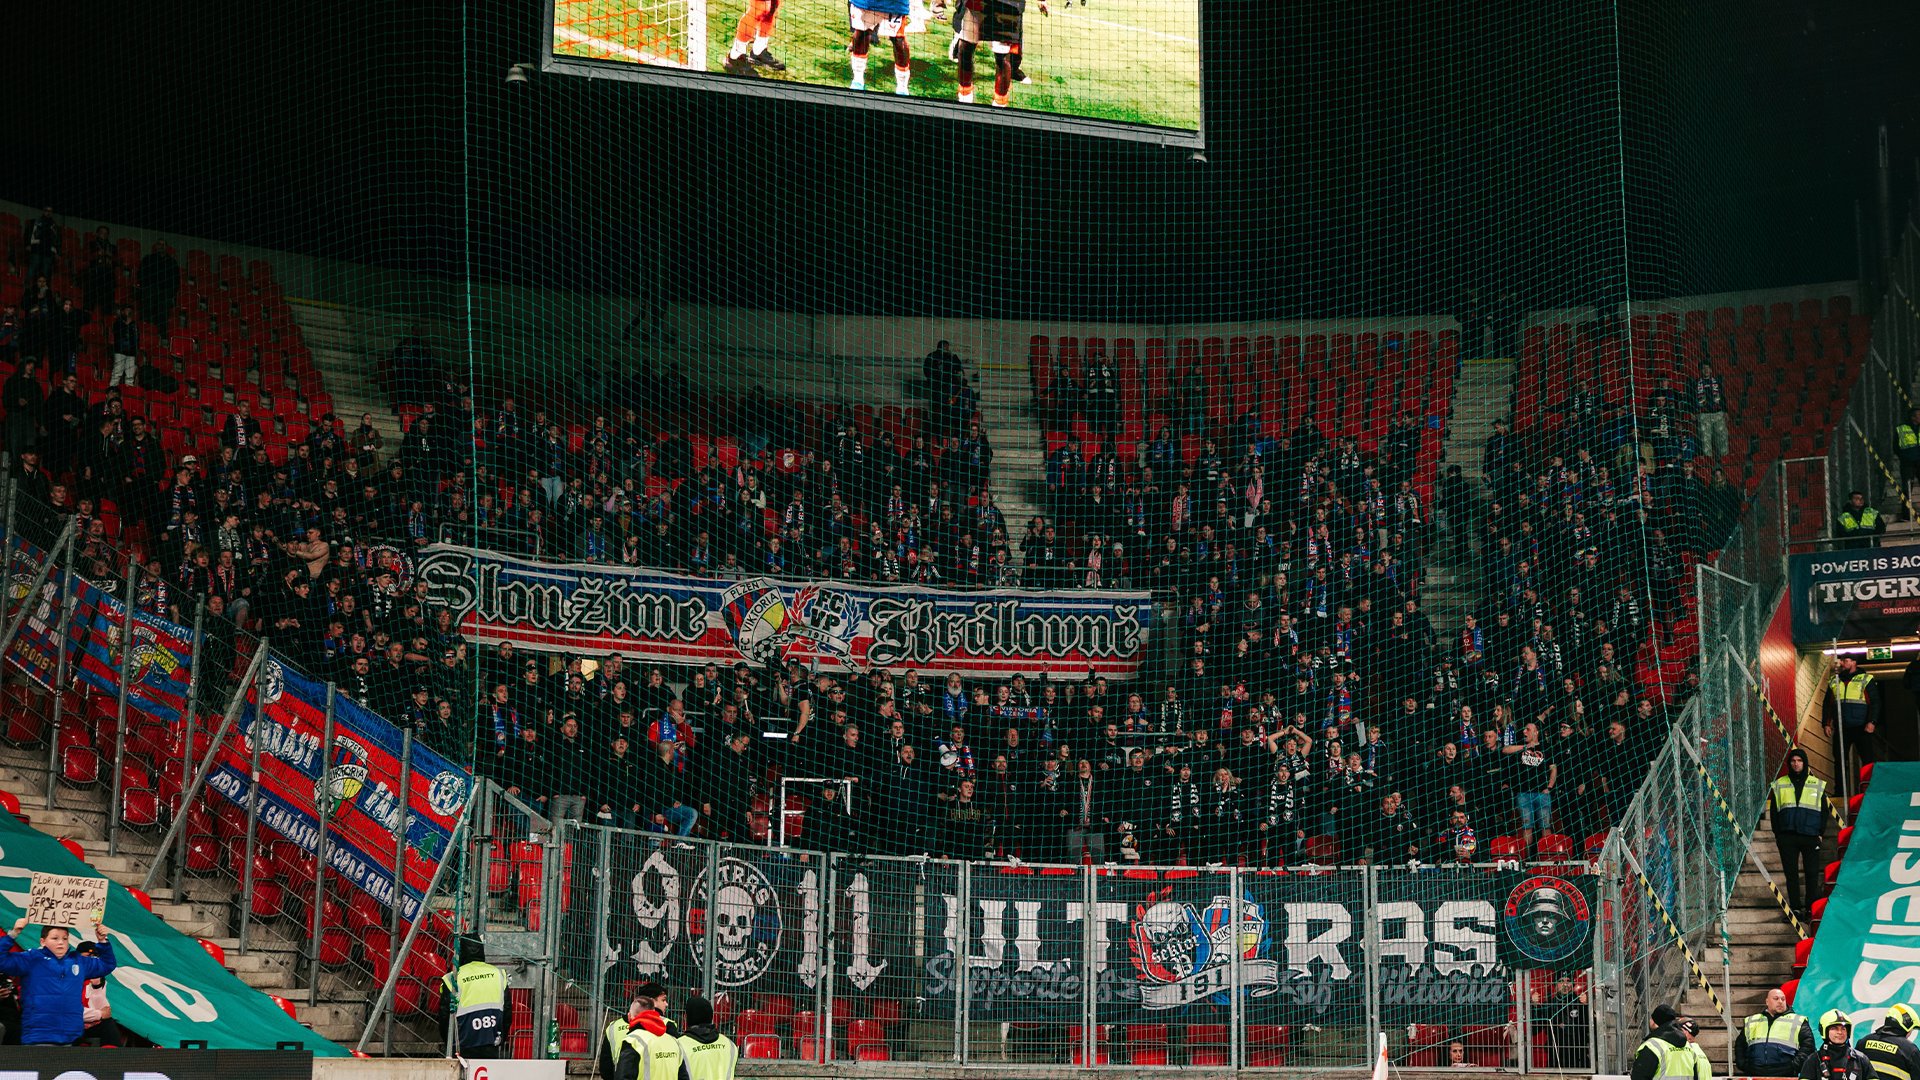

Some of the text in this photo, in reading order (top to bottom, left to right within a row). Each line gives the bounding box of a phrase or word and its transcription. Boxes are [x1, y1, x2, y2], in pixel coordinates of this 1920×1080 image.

[1811, 560, 1869, 576] POWER
[1873, 558, 1889, 571] IS
[1819, 576, 1920, 604] TIGER
[31, 885, 49, 897] CAN
[62, 888, 87, 900] HAVE
[90, 891, 96, 900] A
[28, 896, 62, 910] JERSEY
[28, 907, 80, 926] PLEASE
[461, 972, 496, 984] SECURITY
[692, 1043, 726, 1053] SECURITY
